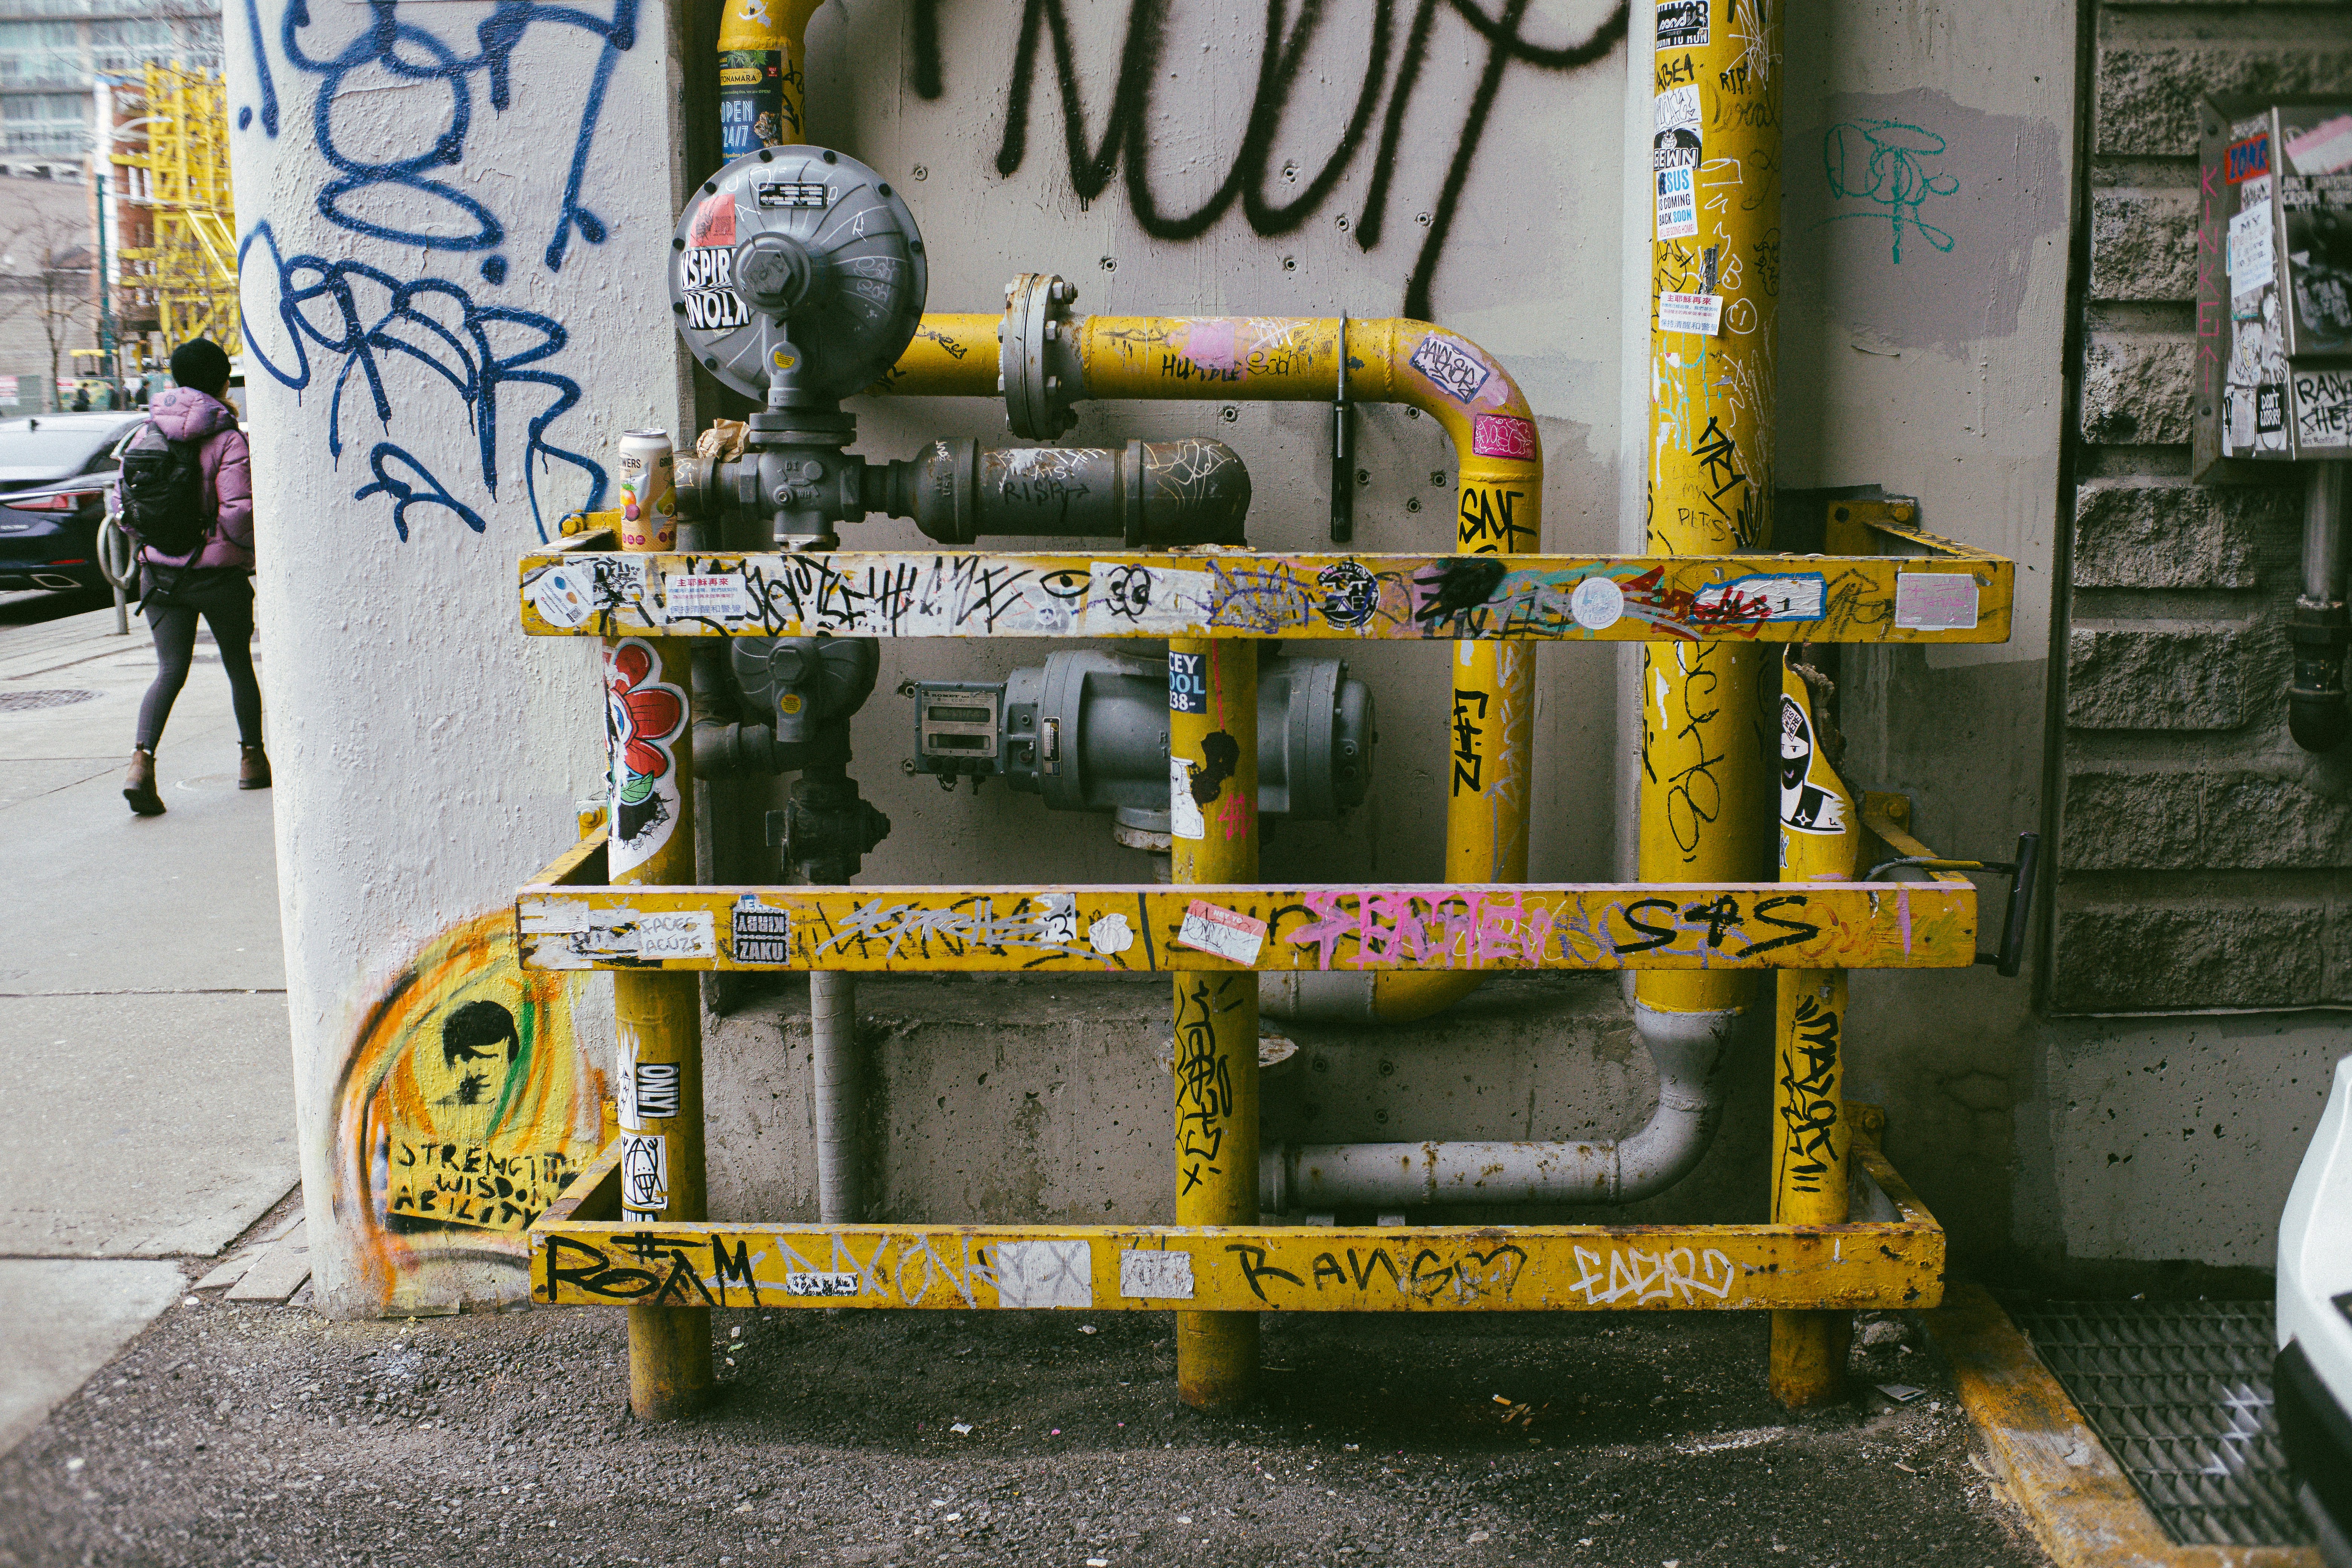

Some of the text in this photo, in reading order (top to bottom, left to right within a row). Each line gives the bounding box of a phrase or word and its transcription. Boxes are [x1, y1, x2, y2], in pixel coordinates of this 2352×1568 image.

[721, 100, 753, 123] OPEN
[723, 125, 749, 148] 24/7
[1658, 193, 1690, 211] IS COMING
[1659, 208, 1692, 226] BACK SOON
[1670, 225, 1681, 235] GOING
[1681, 224, 1695, 234] HOME!
[1787, 714, 1802, 738] HERE
[737, 914, 785, 934] KIRBY
[738, 941, 784, 962] ZAKU
